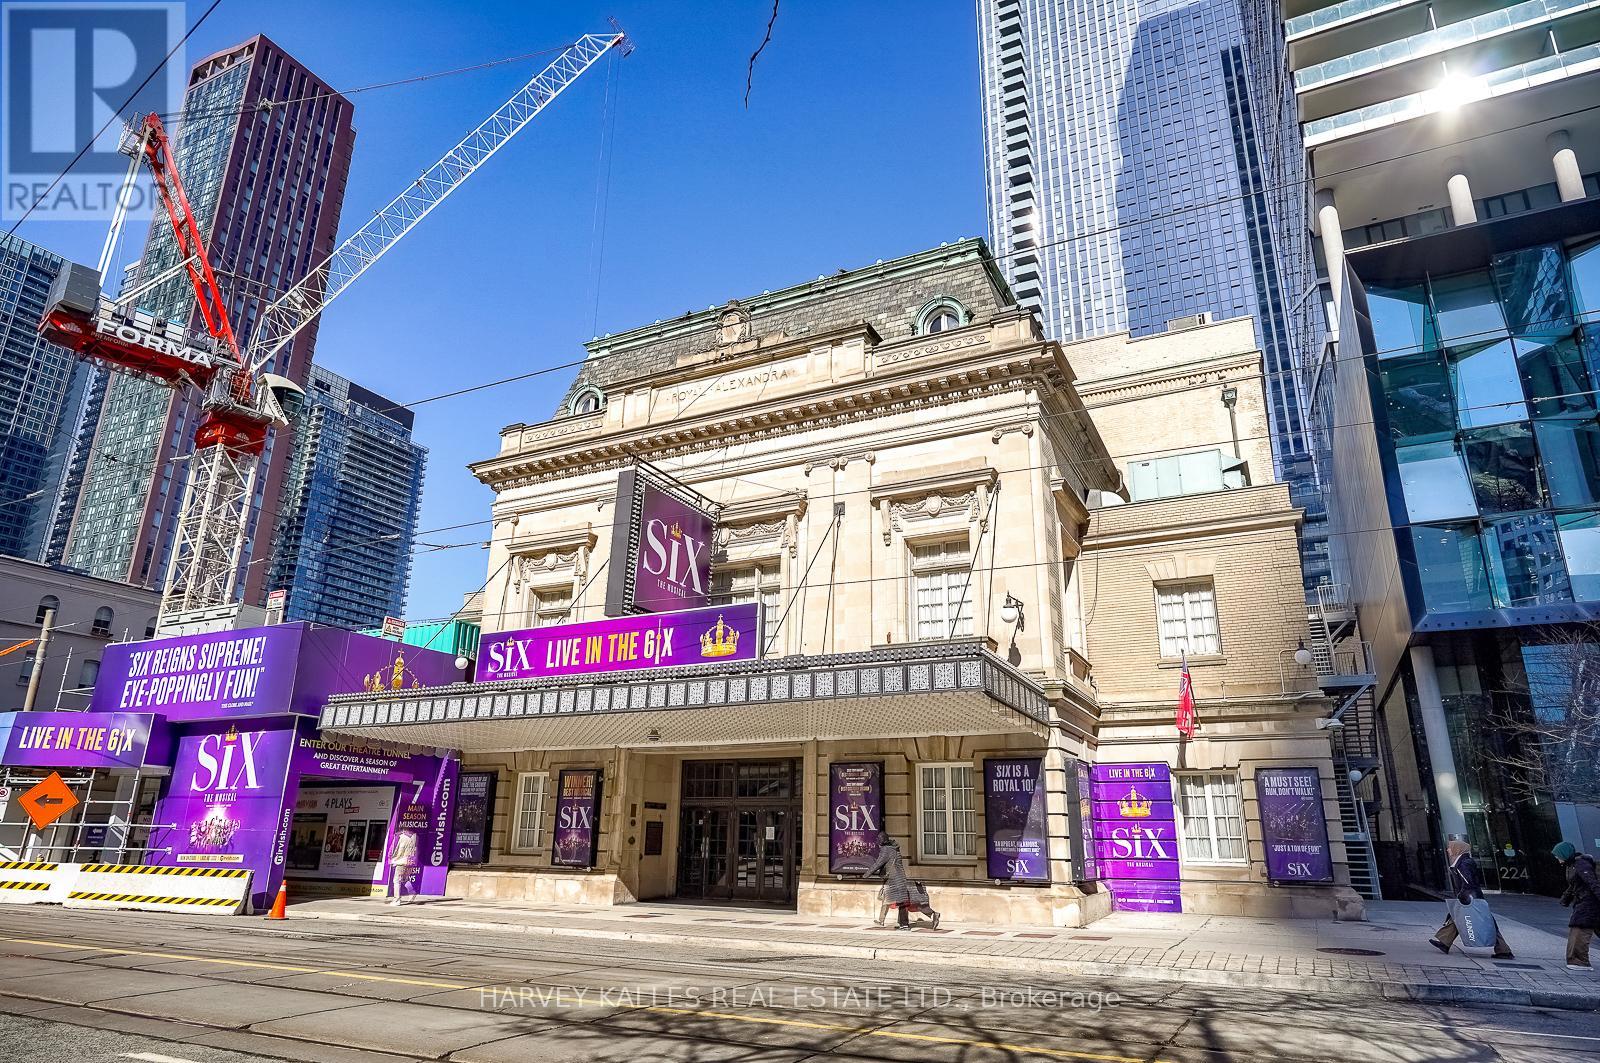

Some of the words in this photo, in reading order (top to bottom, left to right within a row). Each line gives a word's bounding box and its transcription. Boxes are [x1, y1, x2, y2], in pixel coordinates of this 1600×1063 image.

[96, 317, 212, 369] FORMA
[715, 370, 788, 392] ALEXANDRA
[656, 579, 667, 590] THE
[667, 582, 687, 599] MUSICAL
[151, 644, 198, 675] REIGNS
[197, 636, 267, 670] SUPREME!
[545, 637, 582, 668] LIVE
[584, 635, 603, 664] IN
[608, 631, 640, 663] THE
[119, 670, 225, 709] EYE-POPPINGLY
[18, 726, 55, 749] LIVE
[54, 727, 75, 750] IN
[76, 728, 107, 751] THE
[299, 738, 327, 750] ENTER
[328, 741, 347, 752] OUR
[348, 744, 381, 756] THEATRE
[382, 748, 412, 760] TUNNEL
[313, 752, 328, 760] AND
[329, 754, 359, 764] DISCOVER
[365, 758, 388, 767] SEASON
[320, 761, 341, 770] GREAT
[341, 764, 390, 775] ENTERTAINMENT
[1012, 764, 1021, 777] IS
[1024, 764, 1030, 777] A
[1108, 768, 1123, 778] LIVE
[1123, 768, 1130, 778] IN
[1131, 768, 1144, 778] THE
[992, 779, 1020, 792] ROYAL
[1270, 776, 1293, 788] MUST
[1294, 776, 1312, 787] SEE!
[203, 793, 214, 803] THE
[214, 792, 237, 803] MUSICAL
[412, 780, 426, 805] 7
[324, 798, 330, 809] 4
[330, 797, 353, 809] PLAYS
[407, 805, 425, 813] MAIN
[402, 812, 427, 821] SEASON
[398, 820, 429, 829] MUSICALS
[1499, 866, 1529, 880] 224
